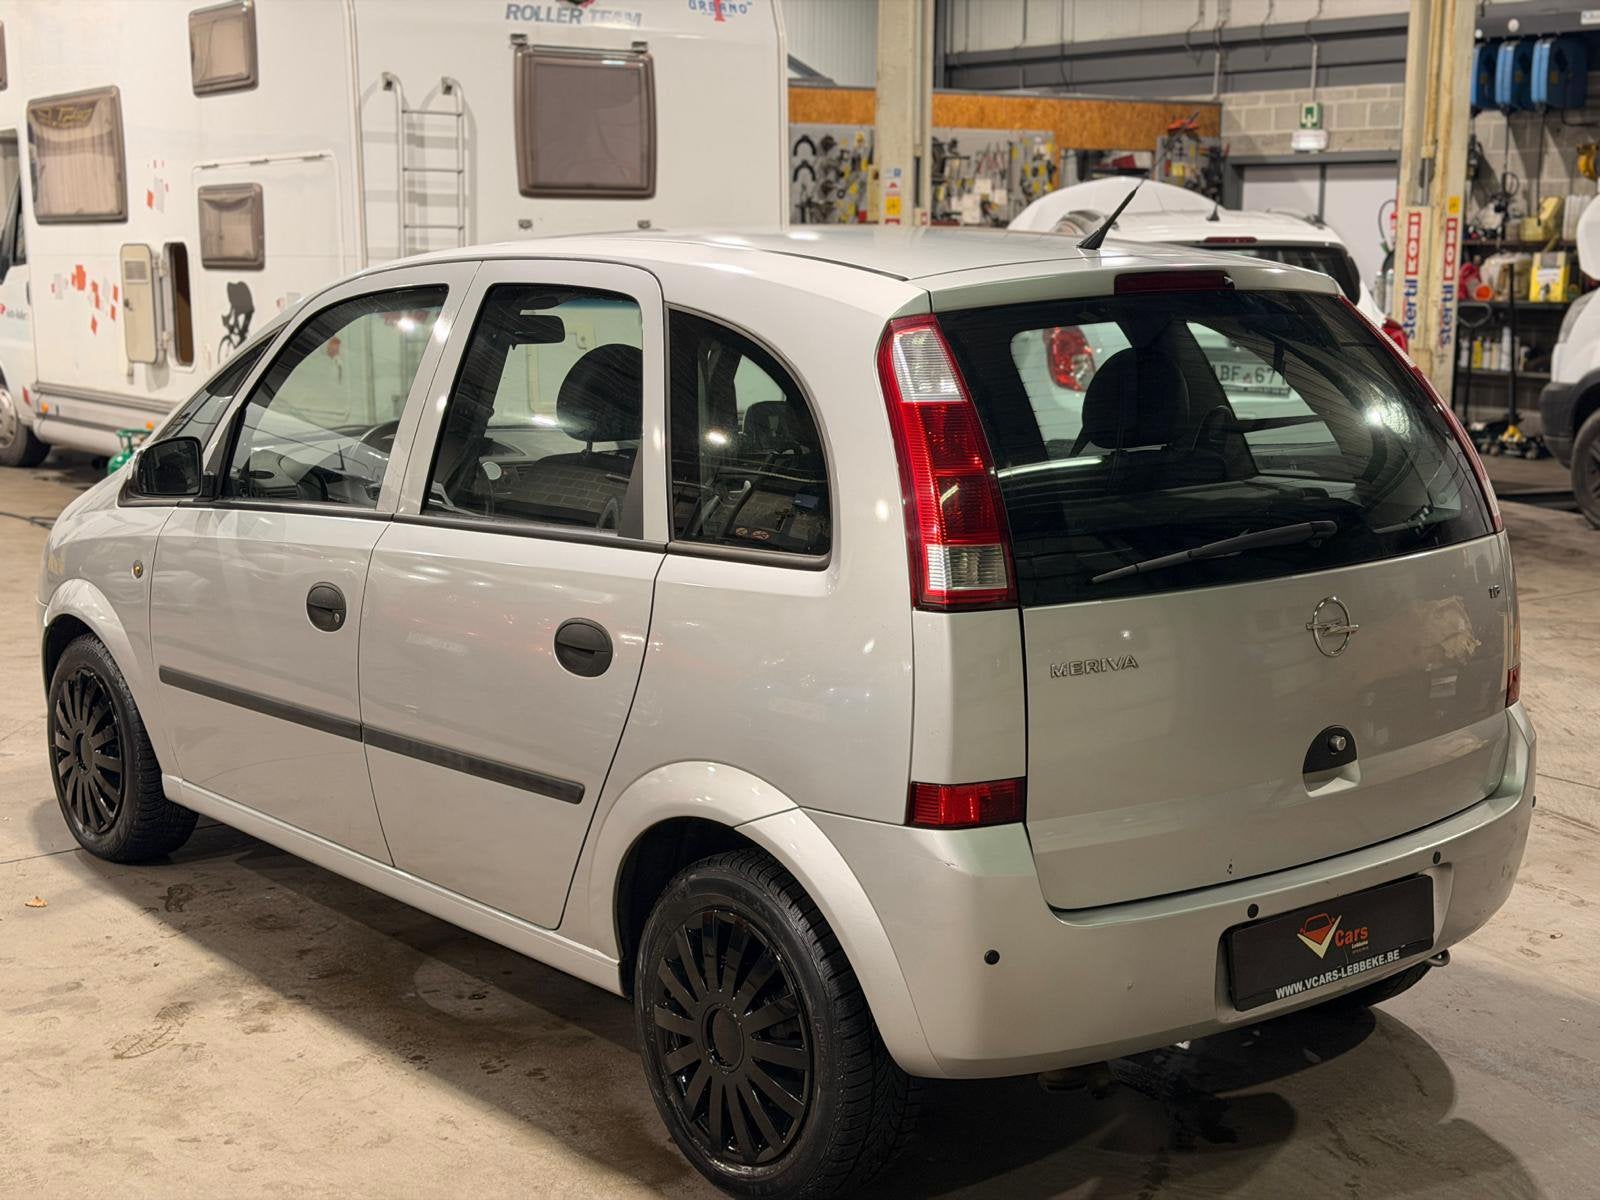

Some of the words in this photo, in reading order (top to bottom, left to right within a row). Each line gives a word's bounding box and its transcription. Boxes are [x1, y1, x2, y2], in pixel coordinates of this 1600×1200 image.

[505, 3, 583, 24] ROLLER
[1405, 212, 1421, 275] KONI
[1443, 218, 1458, 280] KONI
[1441, 285, 1454, 345] stertil
[1050, 655, 1139, 678] MERIVA
[1275, 949, 1400, 999] WWW.VCARS-LEBBEKE.BE
